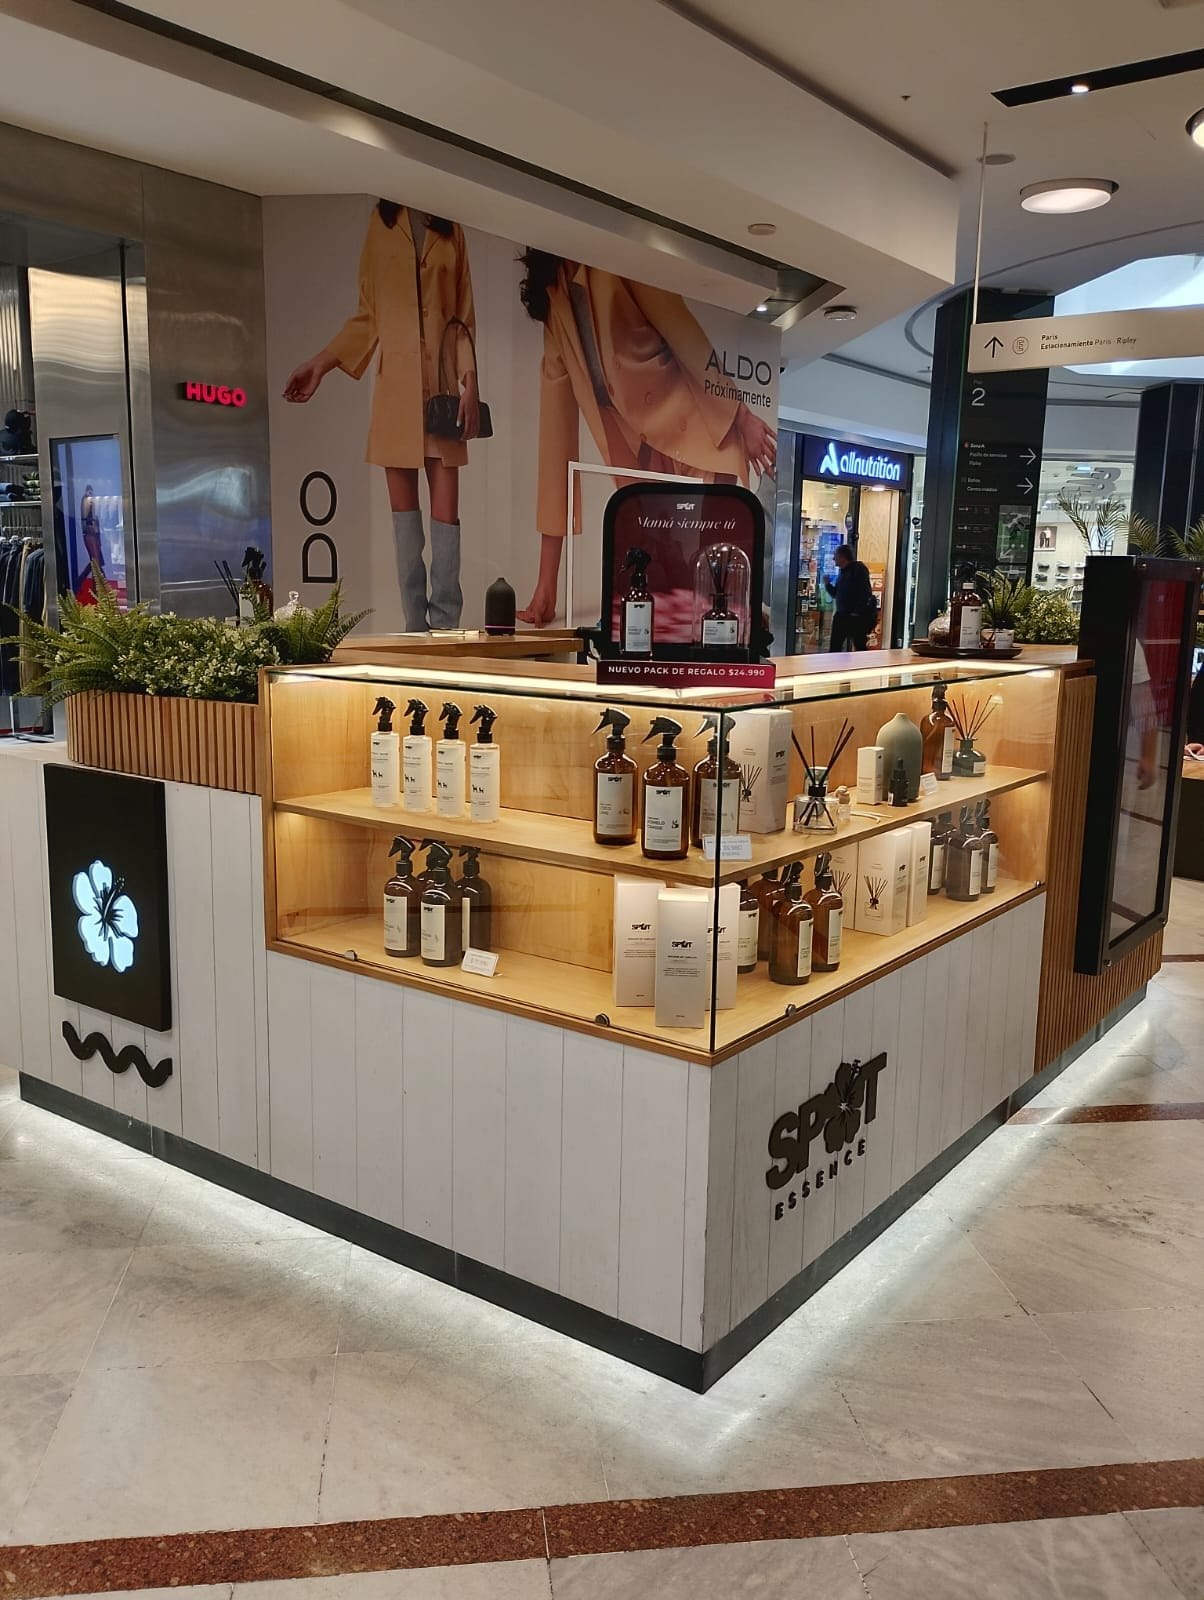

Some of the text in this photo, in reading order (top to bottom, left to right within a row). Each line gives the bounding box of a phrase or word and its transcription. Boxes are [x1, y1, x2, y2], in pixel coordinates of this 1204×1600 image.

[1040, 340, 1093, 350] Estacionamiento
[1116, 337, 1137, 345] Ripley
[705, 349, 772, 385] ALDO
[185, 381, 248, 407] HUGO
[704, 379, 771, 408] Próximamente
[971, 387, 986, 406] 2
[840, 451, 900, 481] allnutrition
[677, 517, 722, 531] siempre
[608, 666, 765, 677] NUEVO PACK DE REGALO $24.990
[765, 1051, 888, 1190] SPOT
[774, 1138, 866, 1221] ESSENCE
